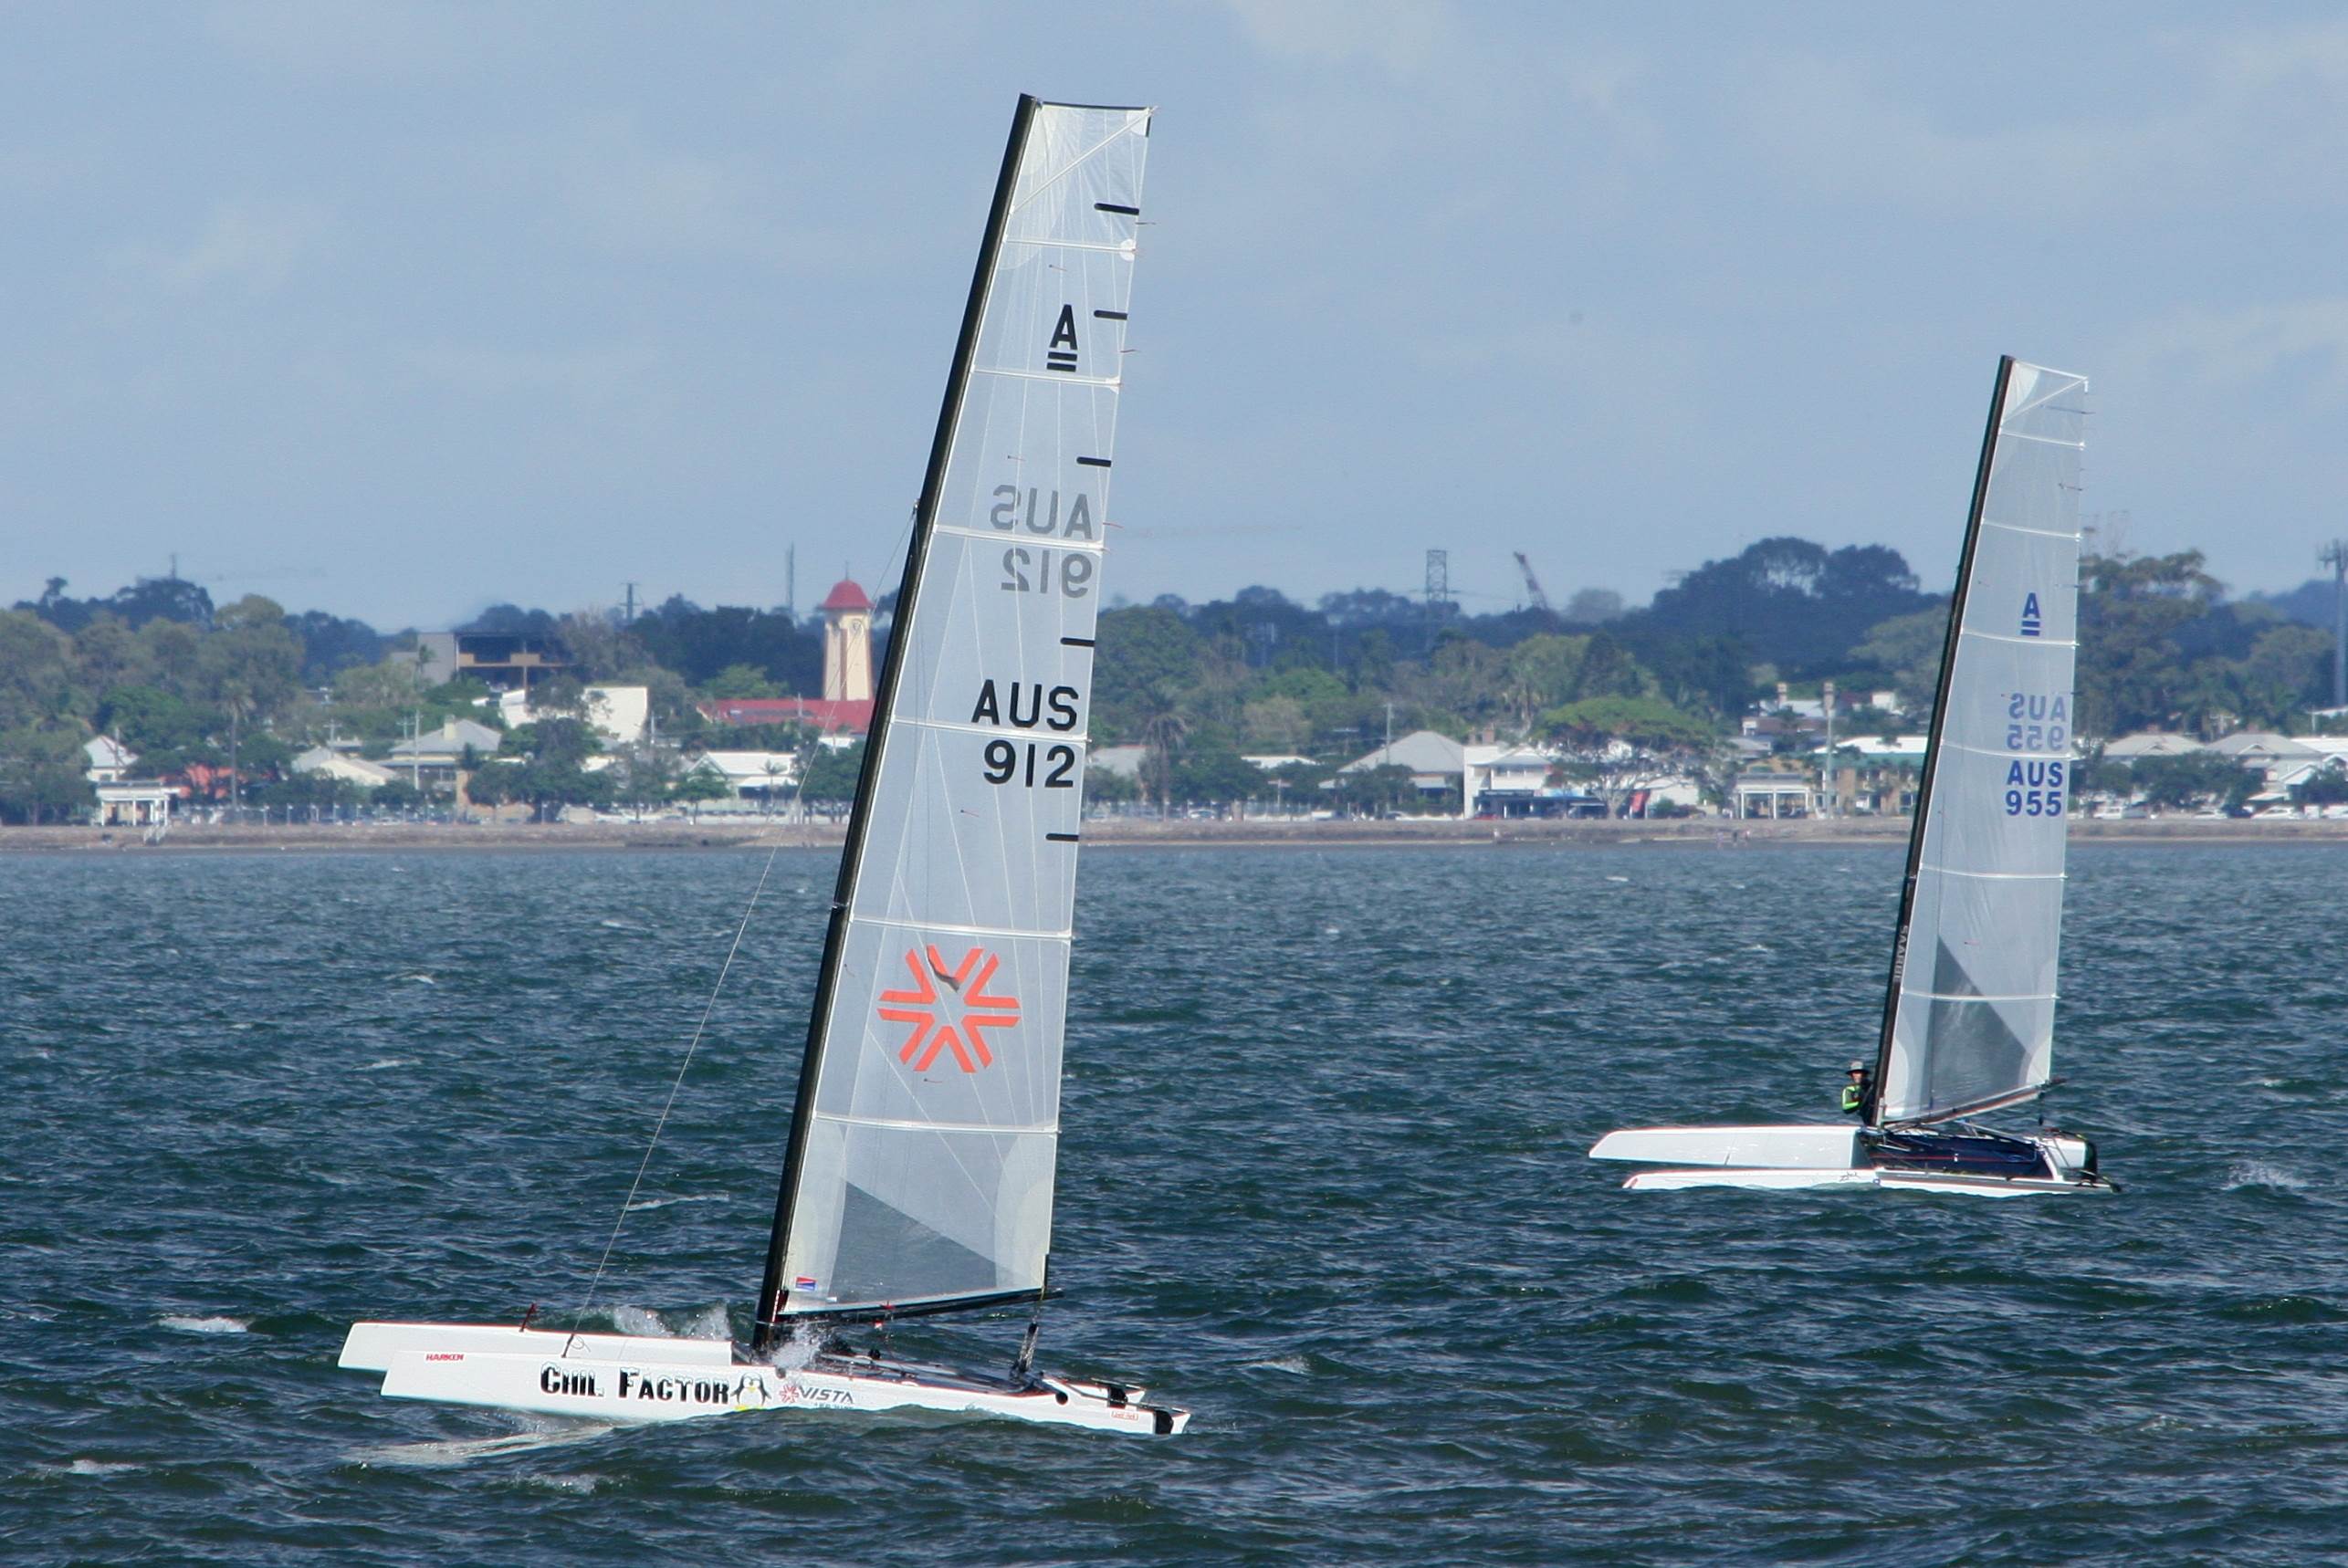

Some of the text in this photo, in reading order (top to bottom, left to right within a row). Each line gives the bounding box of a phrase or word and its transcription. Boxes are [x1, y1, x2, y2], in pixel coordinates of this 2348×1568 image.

[1049, 304, 1078, 350] A
[2022, 592, 2041, 619] A
[970, 679, 1080, 731] AUS
[983, 739, 1075, 788] 912
[2006, 759, 2064, 788] AUS
[2005, 789, 2062, 817] 955
[799, 1385, 854, 1405] VISTA
